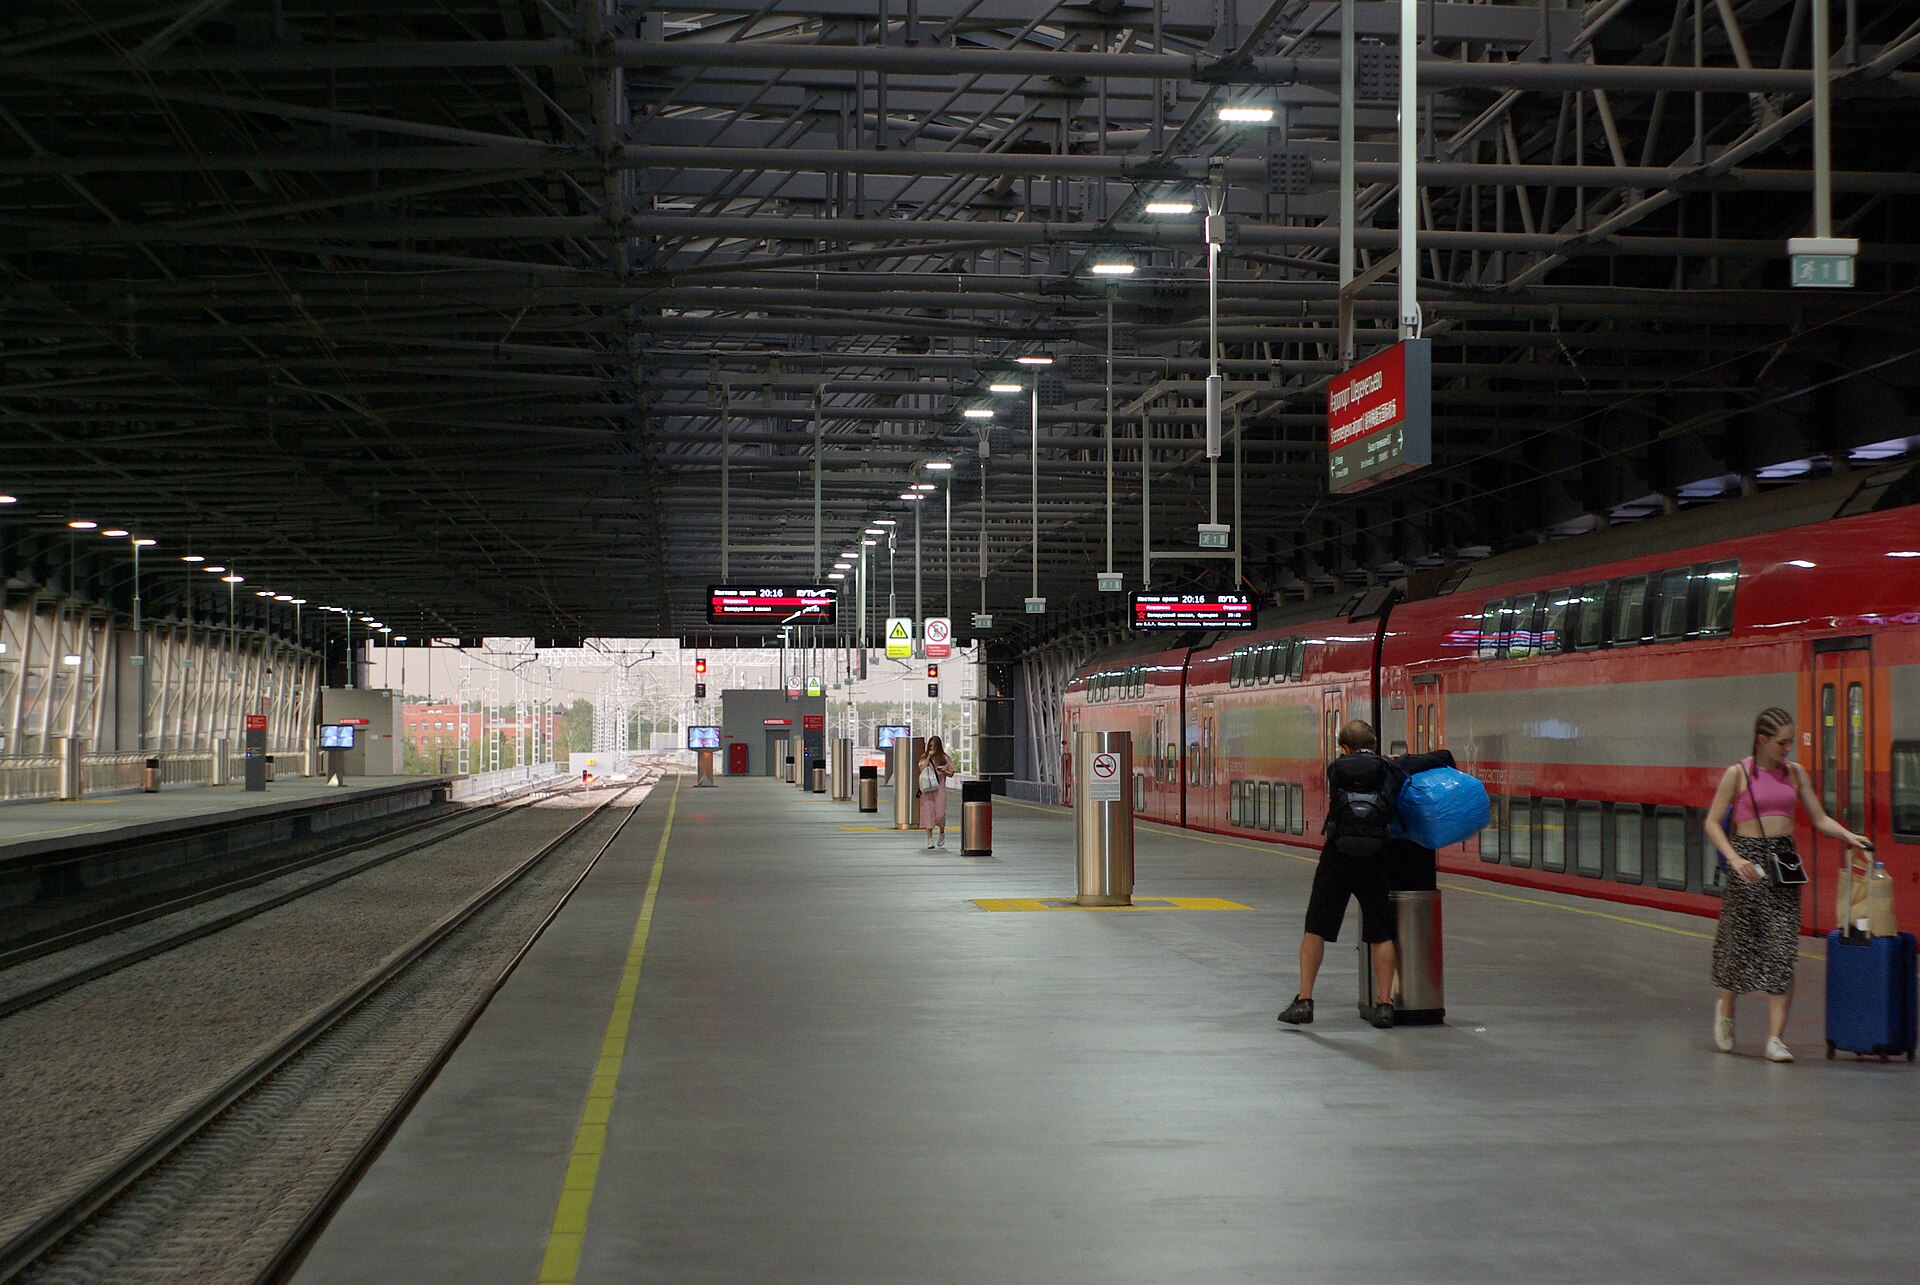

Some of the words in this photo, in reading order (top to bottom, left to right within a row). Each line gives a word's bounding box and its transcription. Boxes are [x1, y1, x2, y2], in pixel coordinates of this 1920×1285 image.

[1330, 387, 1350, 416] Аэропорт
[1351, 371, 1382, 404] Шереметьево
[759, 588, 784, 598] 20:16
[1182, 595, 1205, 603] 20:16
[1218, 595, 1238, 603] ПУТЬ
[1241, 595, 1247, 603] 1
